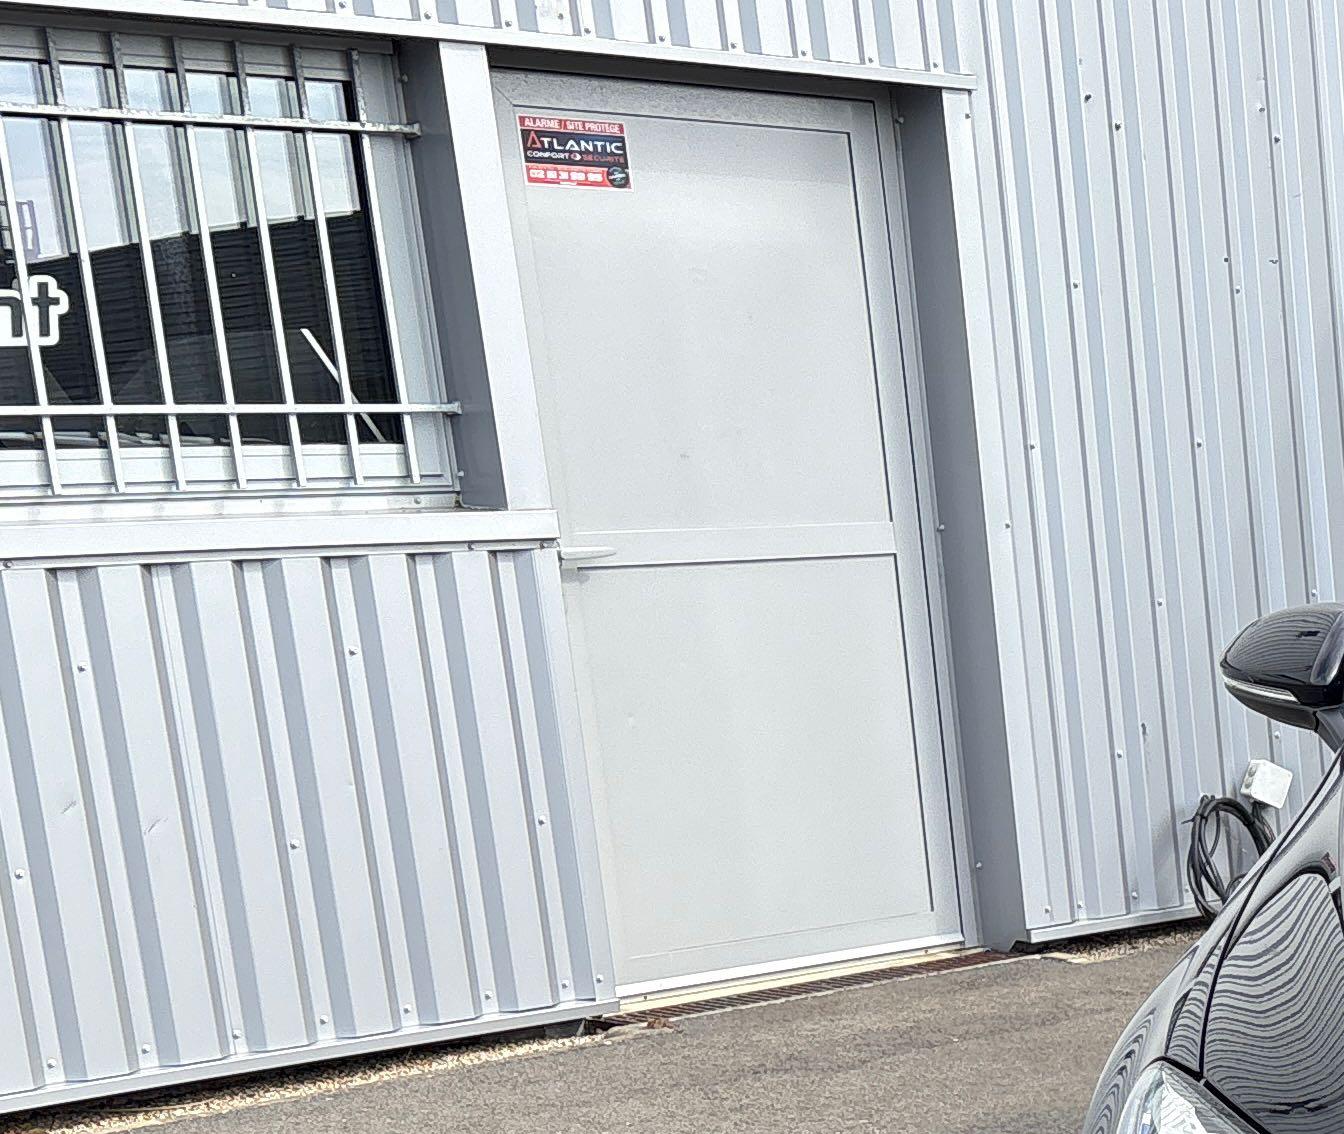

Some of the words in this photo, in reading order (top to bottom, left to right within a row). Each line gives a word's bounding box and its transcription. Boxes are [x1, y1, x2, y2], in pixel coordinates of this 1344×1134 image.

[524, 117, 560, 129] ALARME
[565, 120, 584, 131] SITE
[527, 130, 624, 154] ATLANTIC
